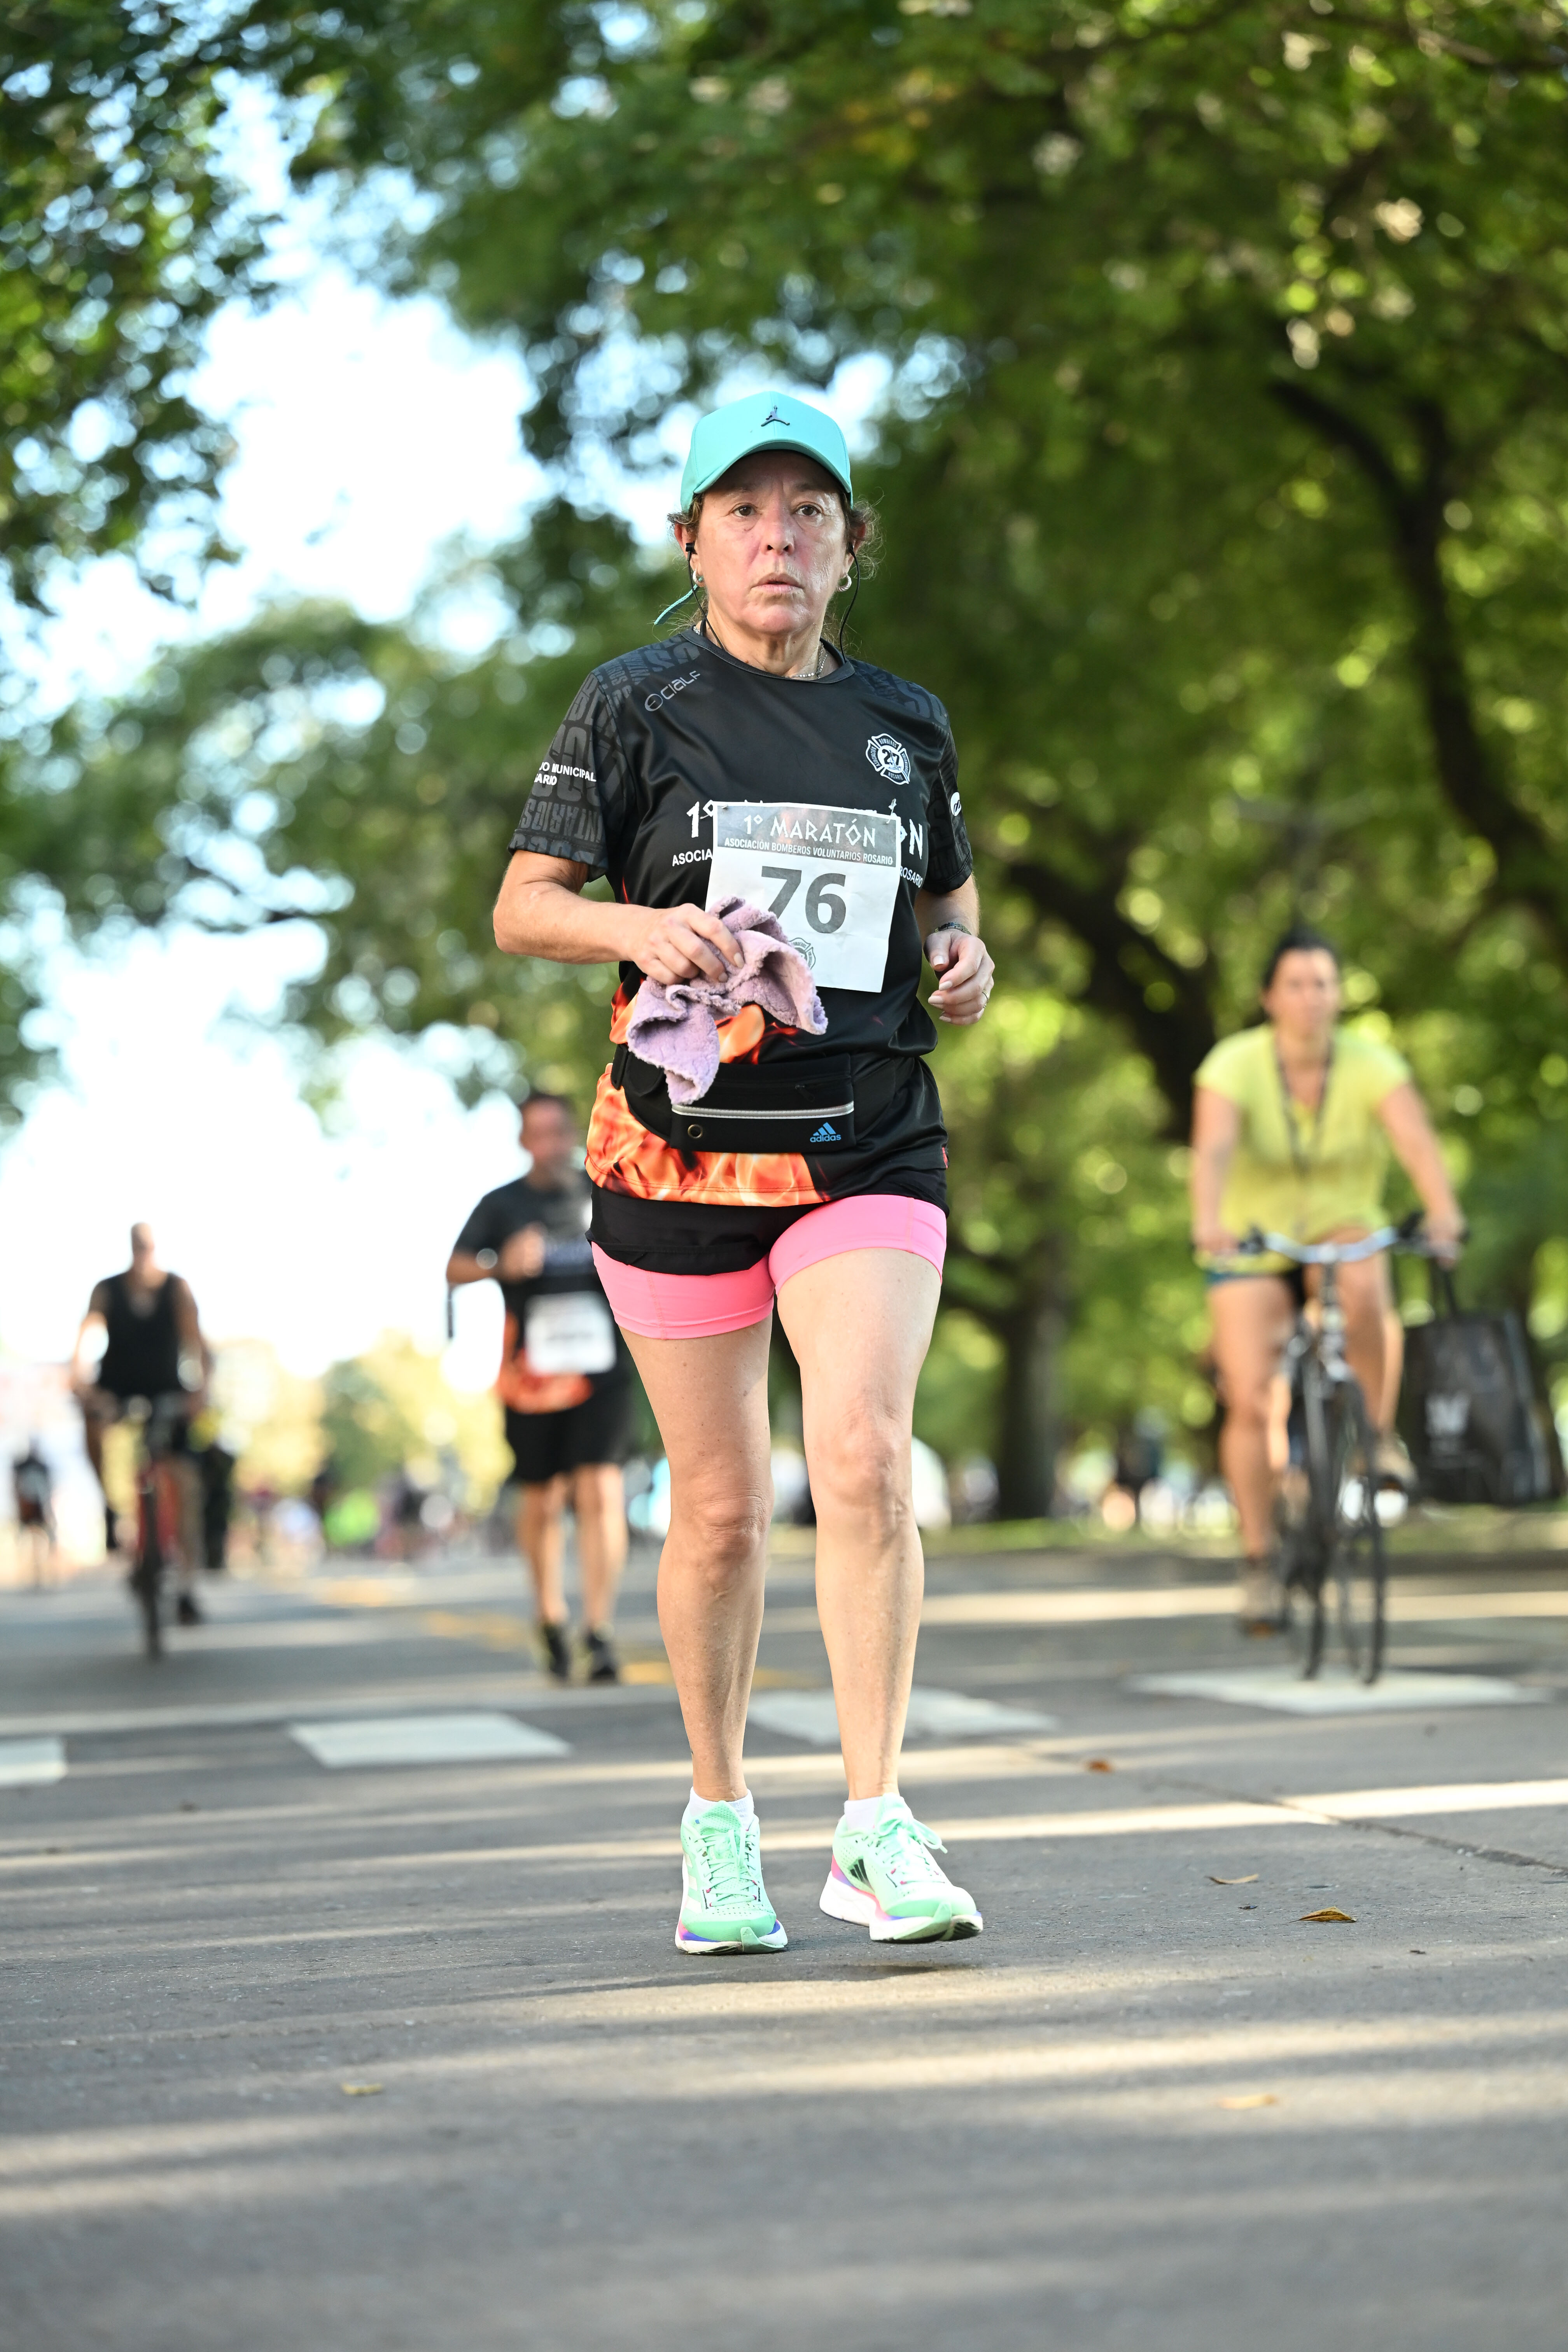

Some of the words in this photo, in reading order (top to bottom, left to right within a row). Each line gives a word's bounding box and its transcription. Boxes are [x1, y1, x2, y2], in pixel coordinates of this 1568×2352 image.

[878, 738, 897, 748] BOMBEROS
[882, 749, 900, 766] 27
[534, 773, 557, 786] ARIO
[551, 763, 597, 782] MUNICIPAL
[770, 816, 875, 848] MARATÓN
[672, 849, 713, 867] ASOCIA
[724, 837, 770, 850] ASOCIACIÓN
[772, 842, 811, 855] BOMBEROS
[813, 847, 861, 861] VOLUNTARIOS
[863, 853, 893, 865] ROSARIO
[761, 866, 846, 934] 76
[810, 1134, 841, 1143] adidas
